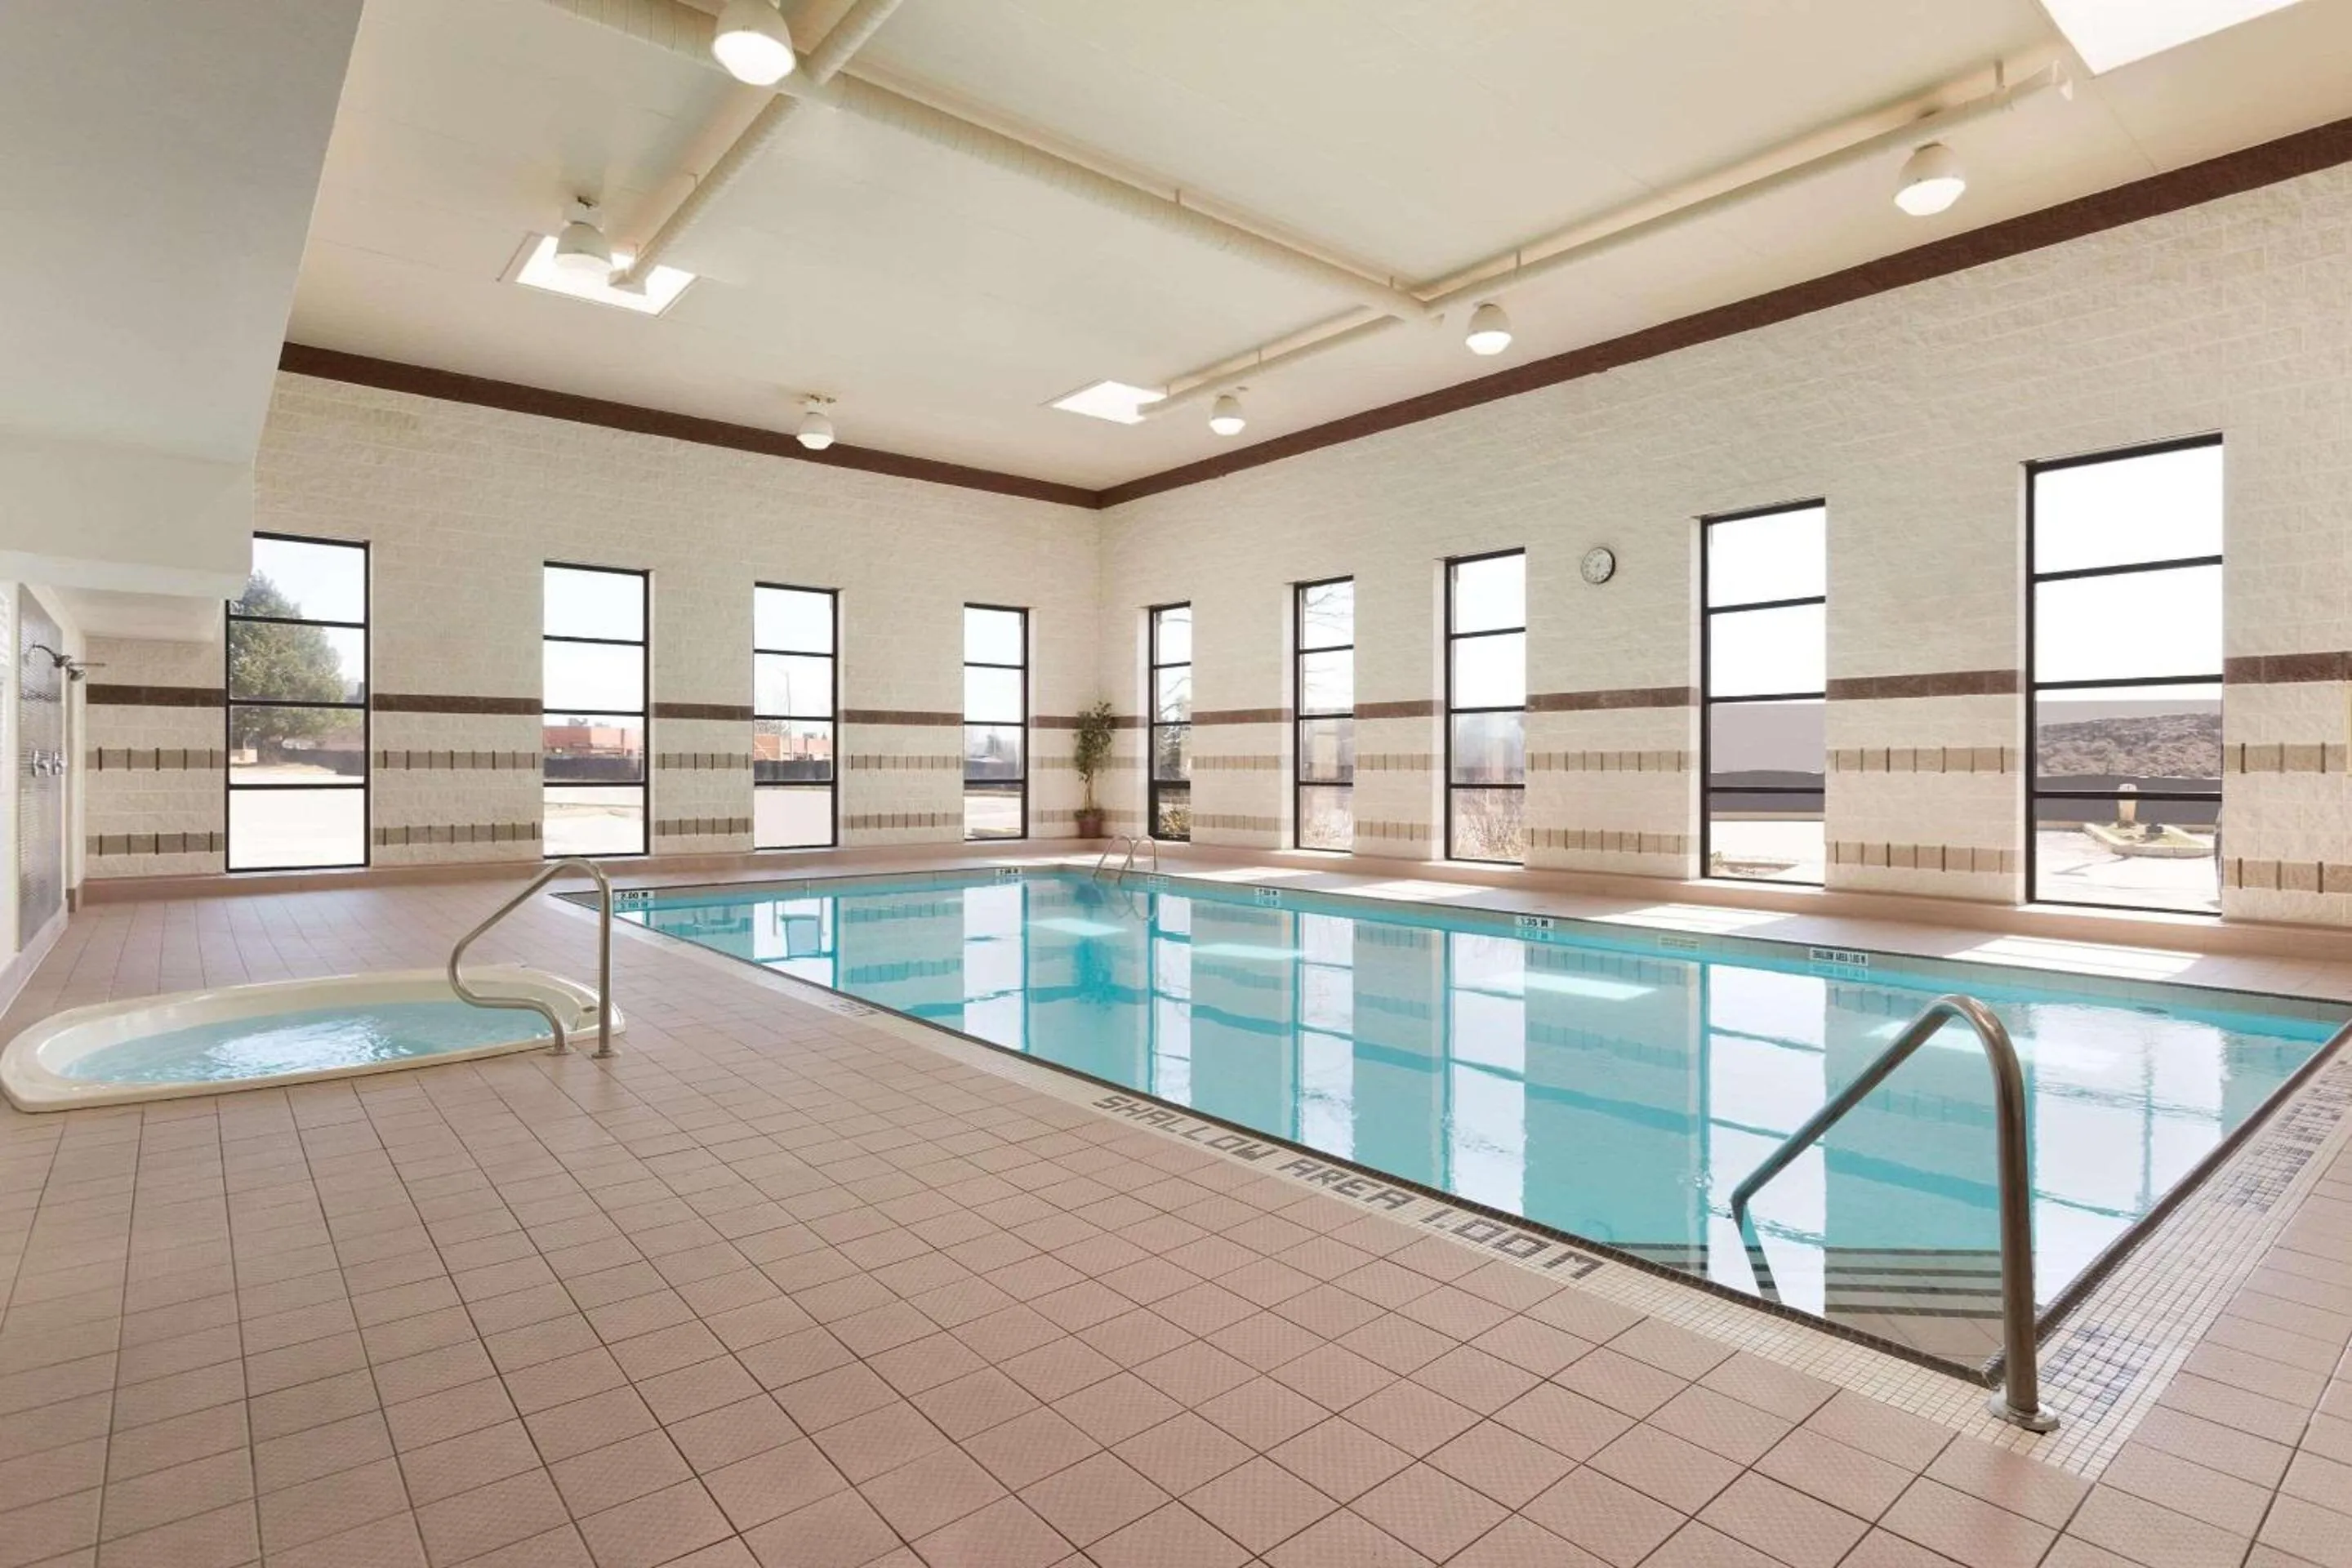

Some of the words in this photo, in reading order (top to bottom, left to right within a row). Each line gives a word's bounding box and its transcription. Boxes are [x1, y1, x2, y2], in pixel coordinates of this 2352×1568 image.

[1093, 1095, 1280, 1161] SHALLOW
[1276, 1158, 1417, 1210] AREA
[1420, 1209, 1551, 1259] 1.00
[1543, 1250, 1605, 1280] M
